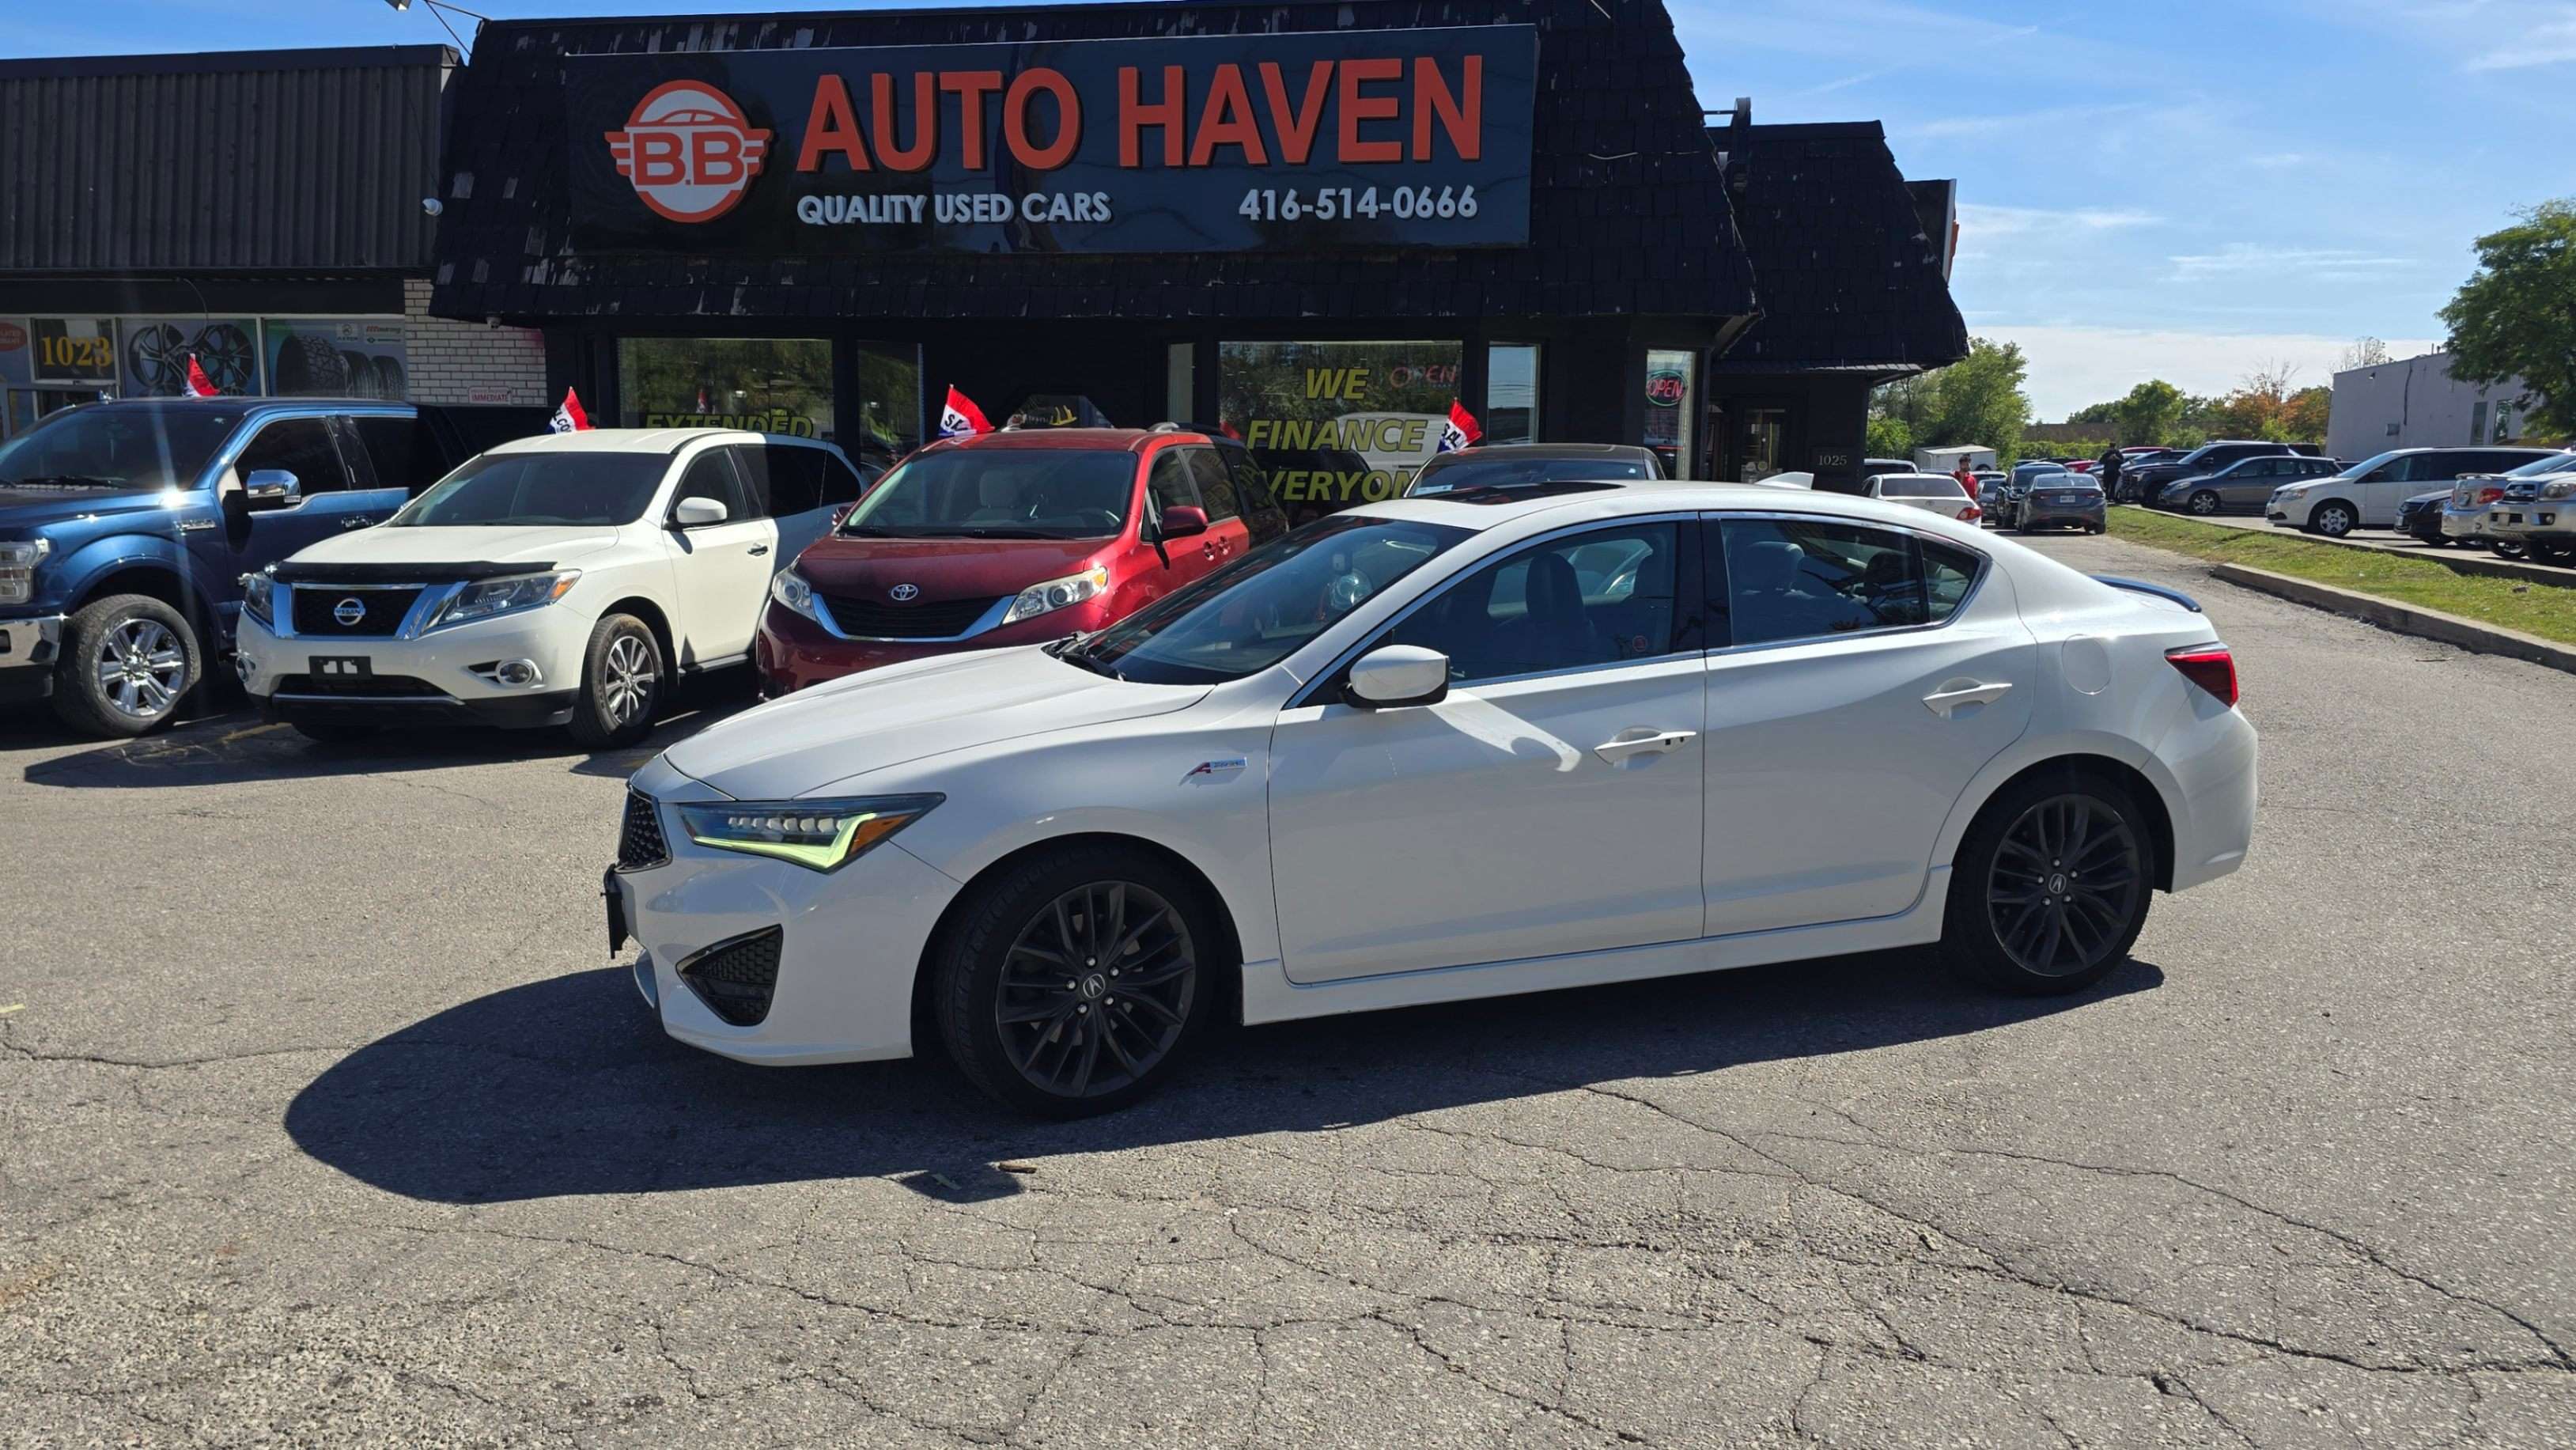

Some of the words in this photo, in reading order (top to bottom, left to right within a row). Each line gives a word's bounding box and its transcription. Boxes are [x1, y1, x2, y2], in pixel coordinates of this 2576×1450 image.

[796, 67, 1084, 172] AUTO
[1118, 55, 1484, 168] HAVEN
[796, 194, 928, 226] QUALITY
[934, 194, 1014, 224] USED
[1021, 191, 1112, 222] CARS
[1239, 184, 1478, 221] 416-514-0666
[40, 335, 114, 367] 1023
[1306, 368, 1371, 399] WE
[1647, 378, 1684, 398] OPEN
[1246, 418, 1427, 452] FINANCE
[1818, 455, 1848, 466] 1025
